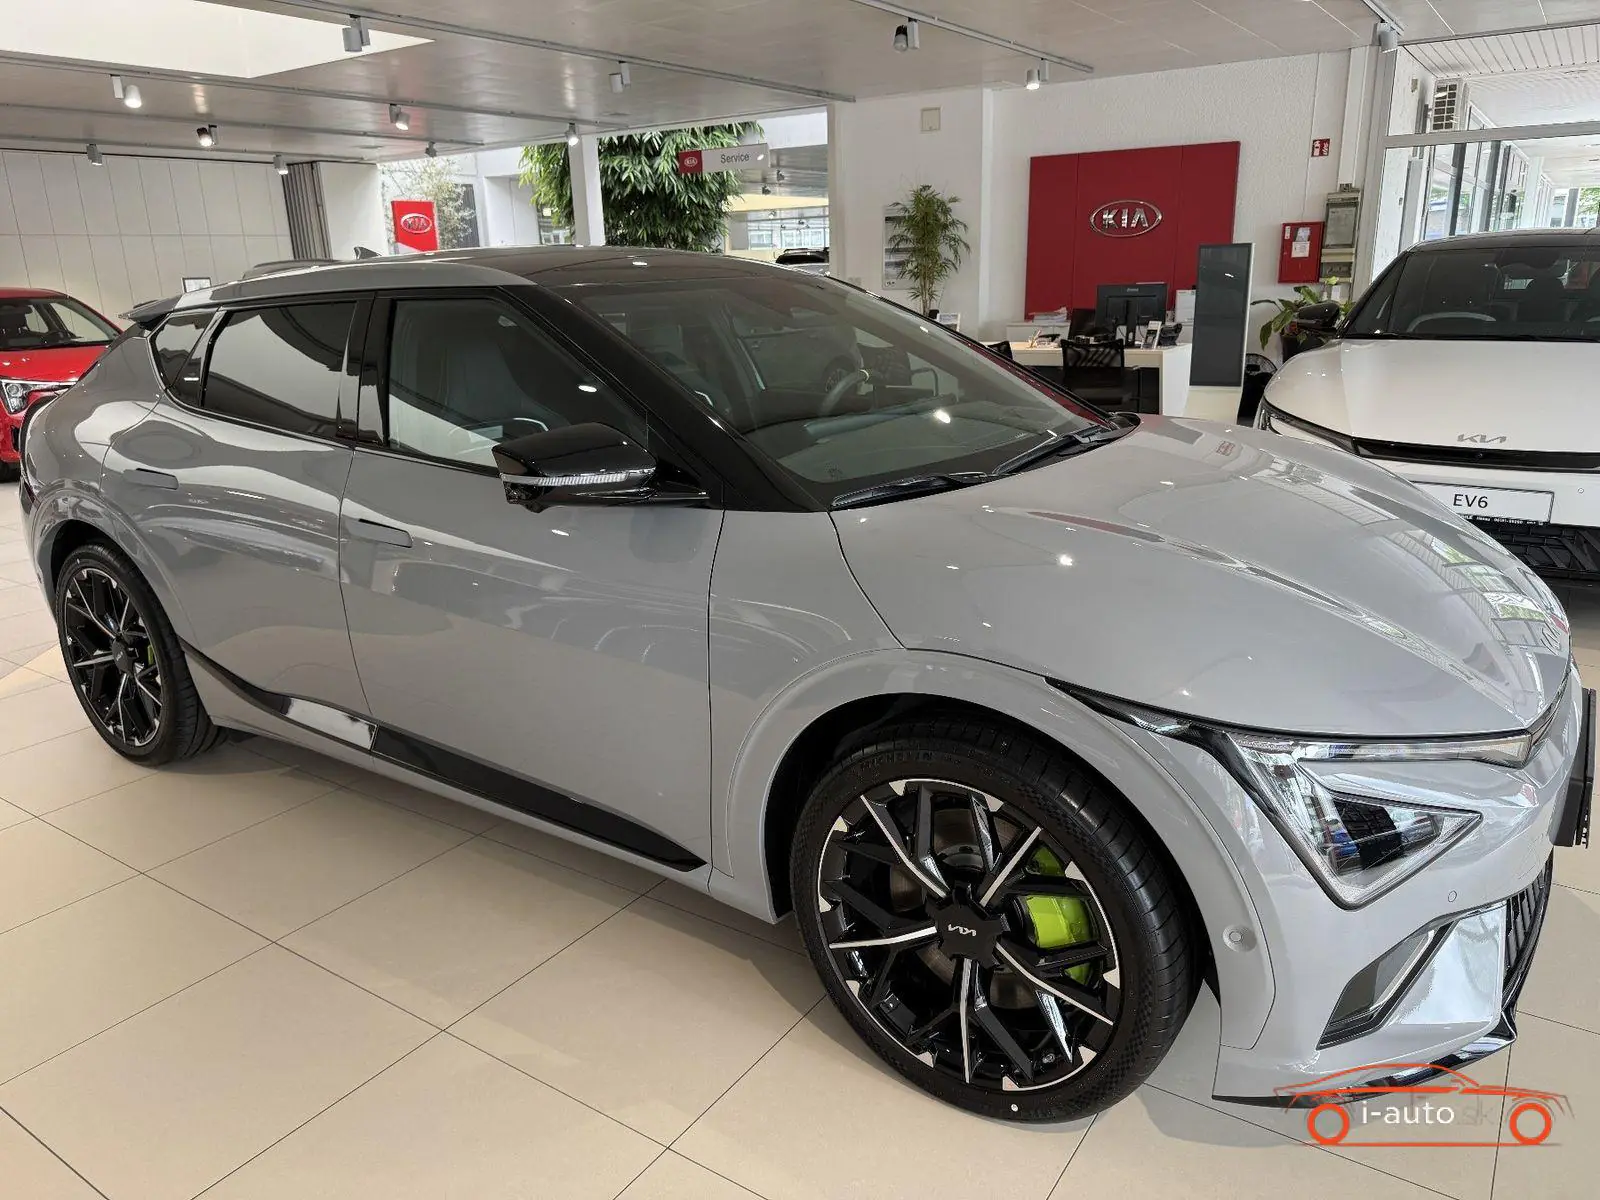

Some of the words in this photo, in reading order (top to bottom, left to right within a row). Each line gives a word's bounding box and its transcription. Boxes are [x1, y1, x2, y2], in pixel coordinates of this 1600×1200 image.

[720, 153, 750, 164] Service
[1102, 207, 1149, 228] KIA
[1453, 493, 1489, 508] EV6
